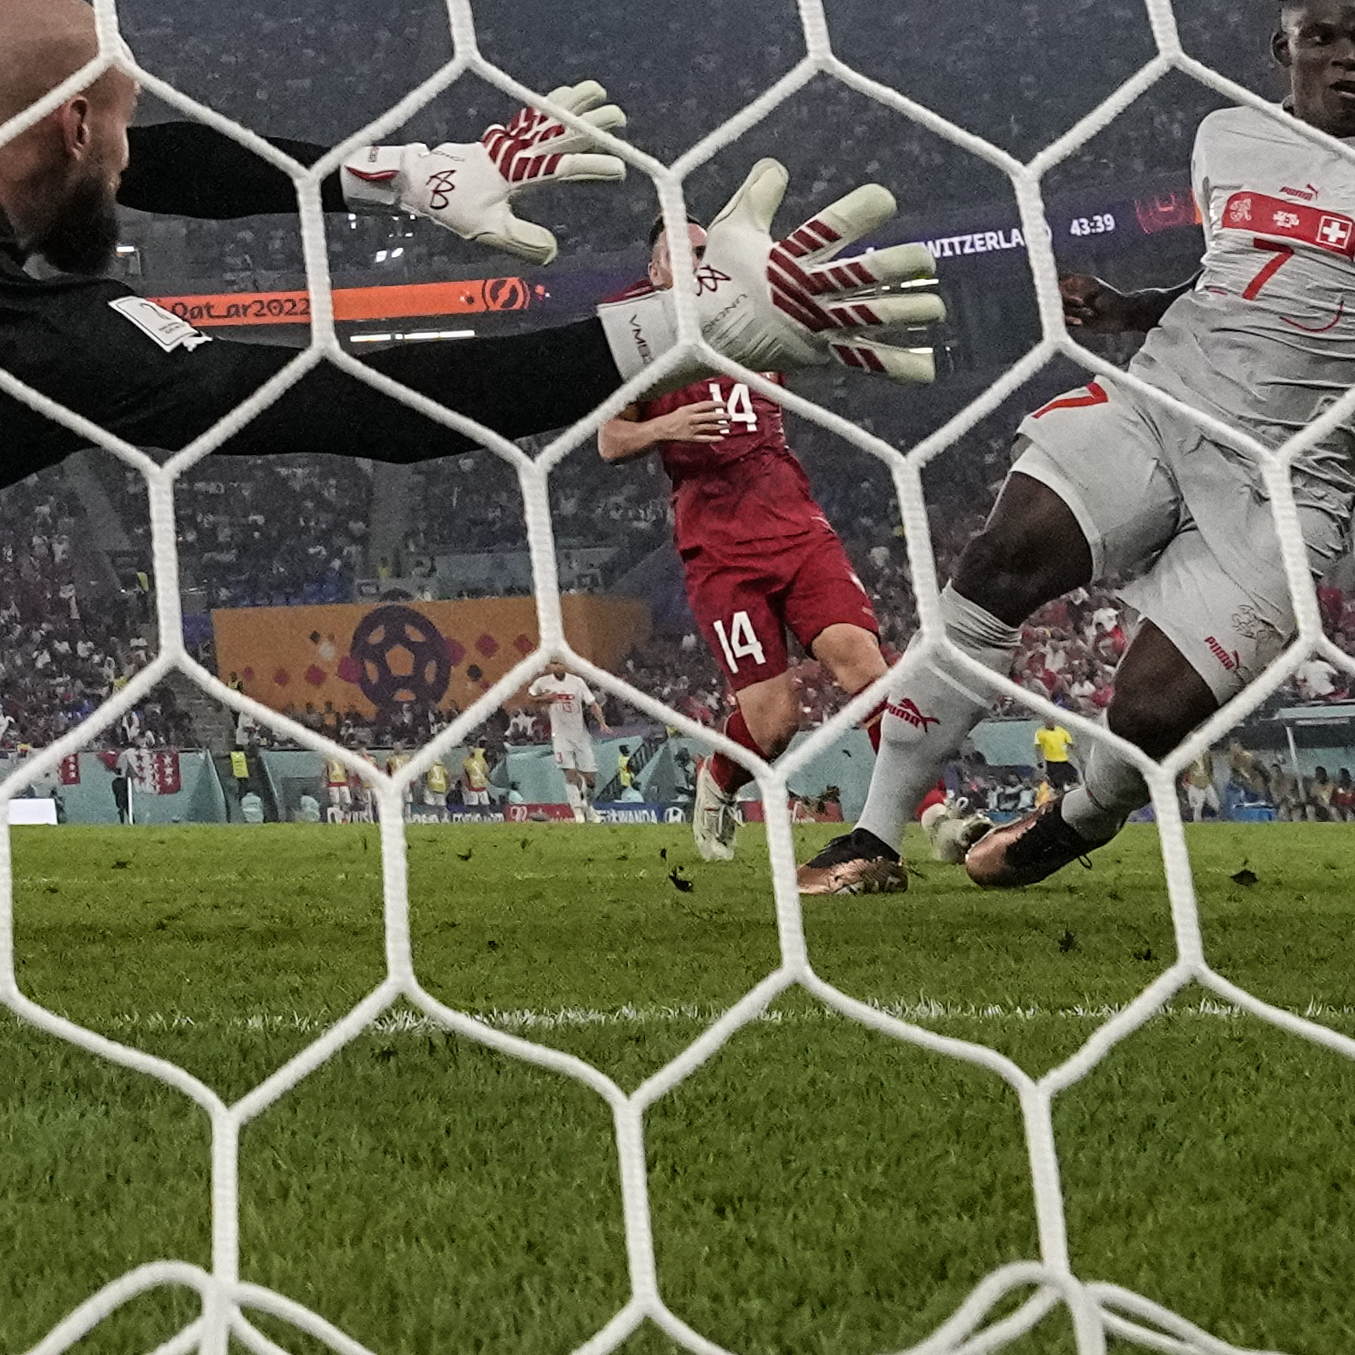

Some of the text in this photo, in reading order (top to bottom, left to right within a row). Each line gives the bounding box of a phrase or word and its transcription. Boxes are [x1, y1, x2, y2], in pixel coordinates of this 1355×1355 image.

[1069, 213, 1116, 237] 43:39
[1242, 237, 1295, 302] 7
[709, 383, 759, 434] 14
[1031, 381, 1109, 420] 7
[713, 611, 766, 674] 14
